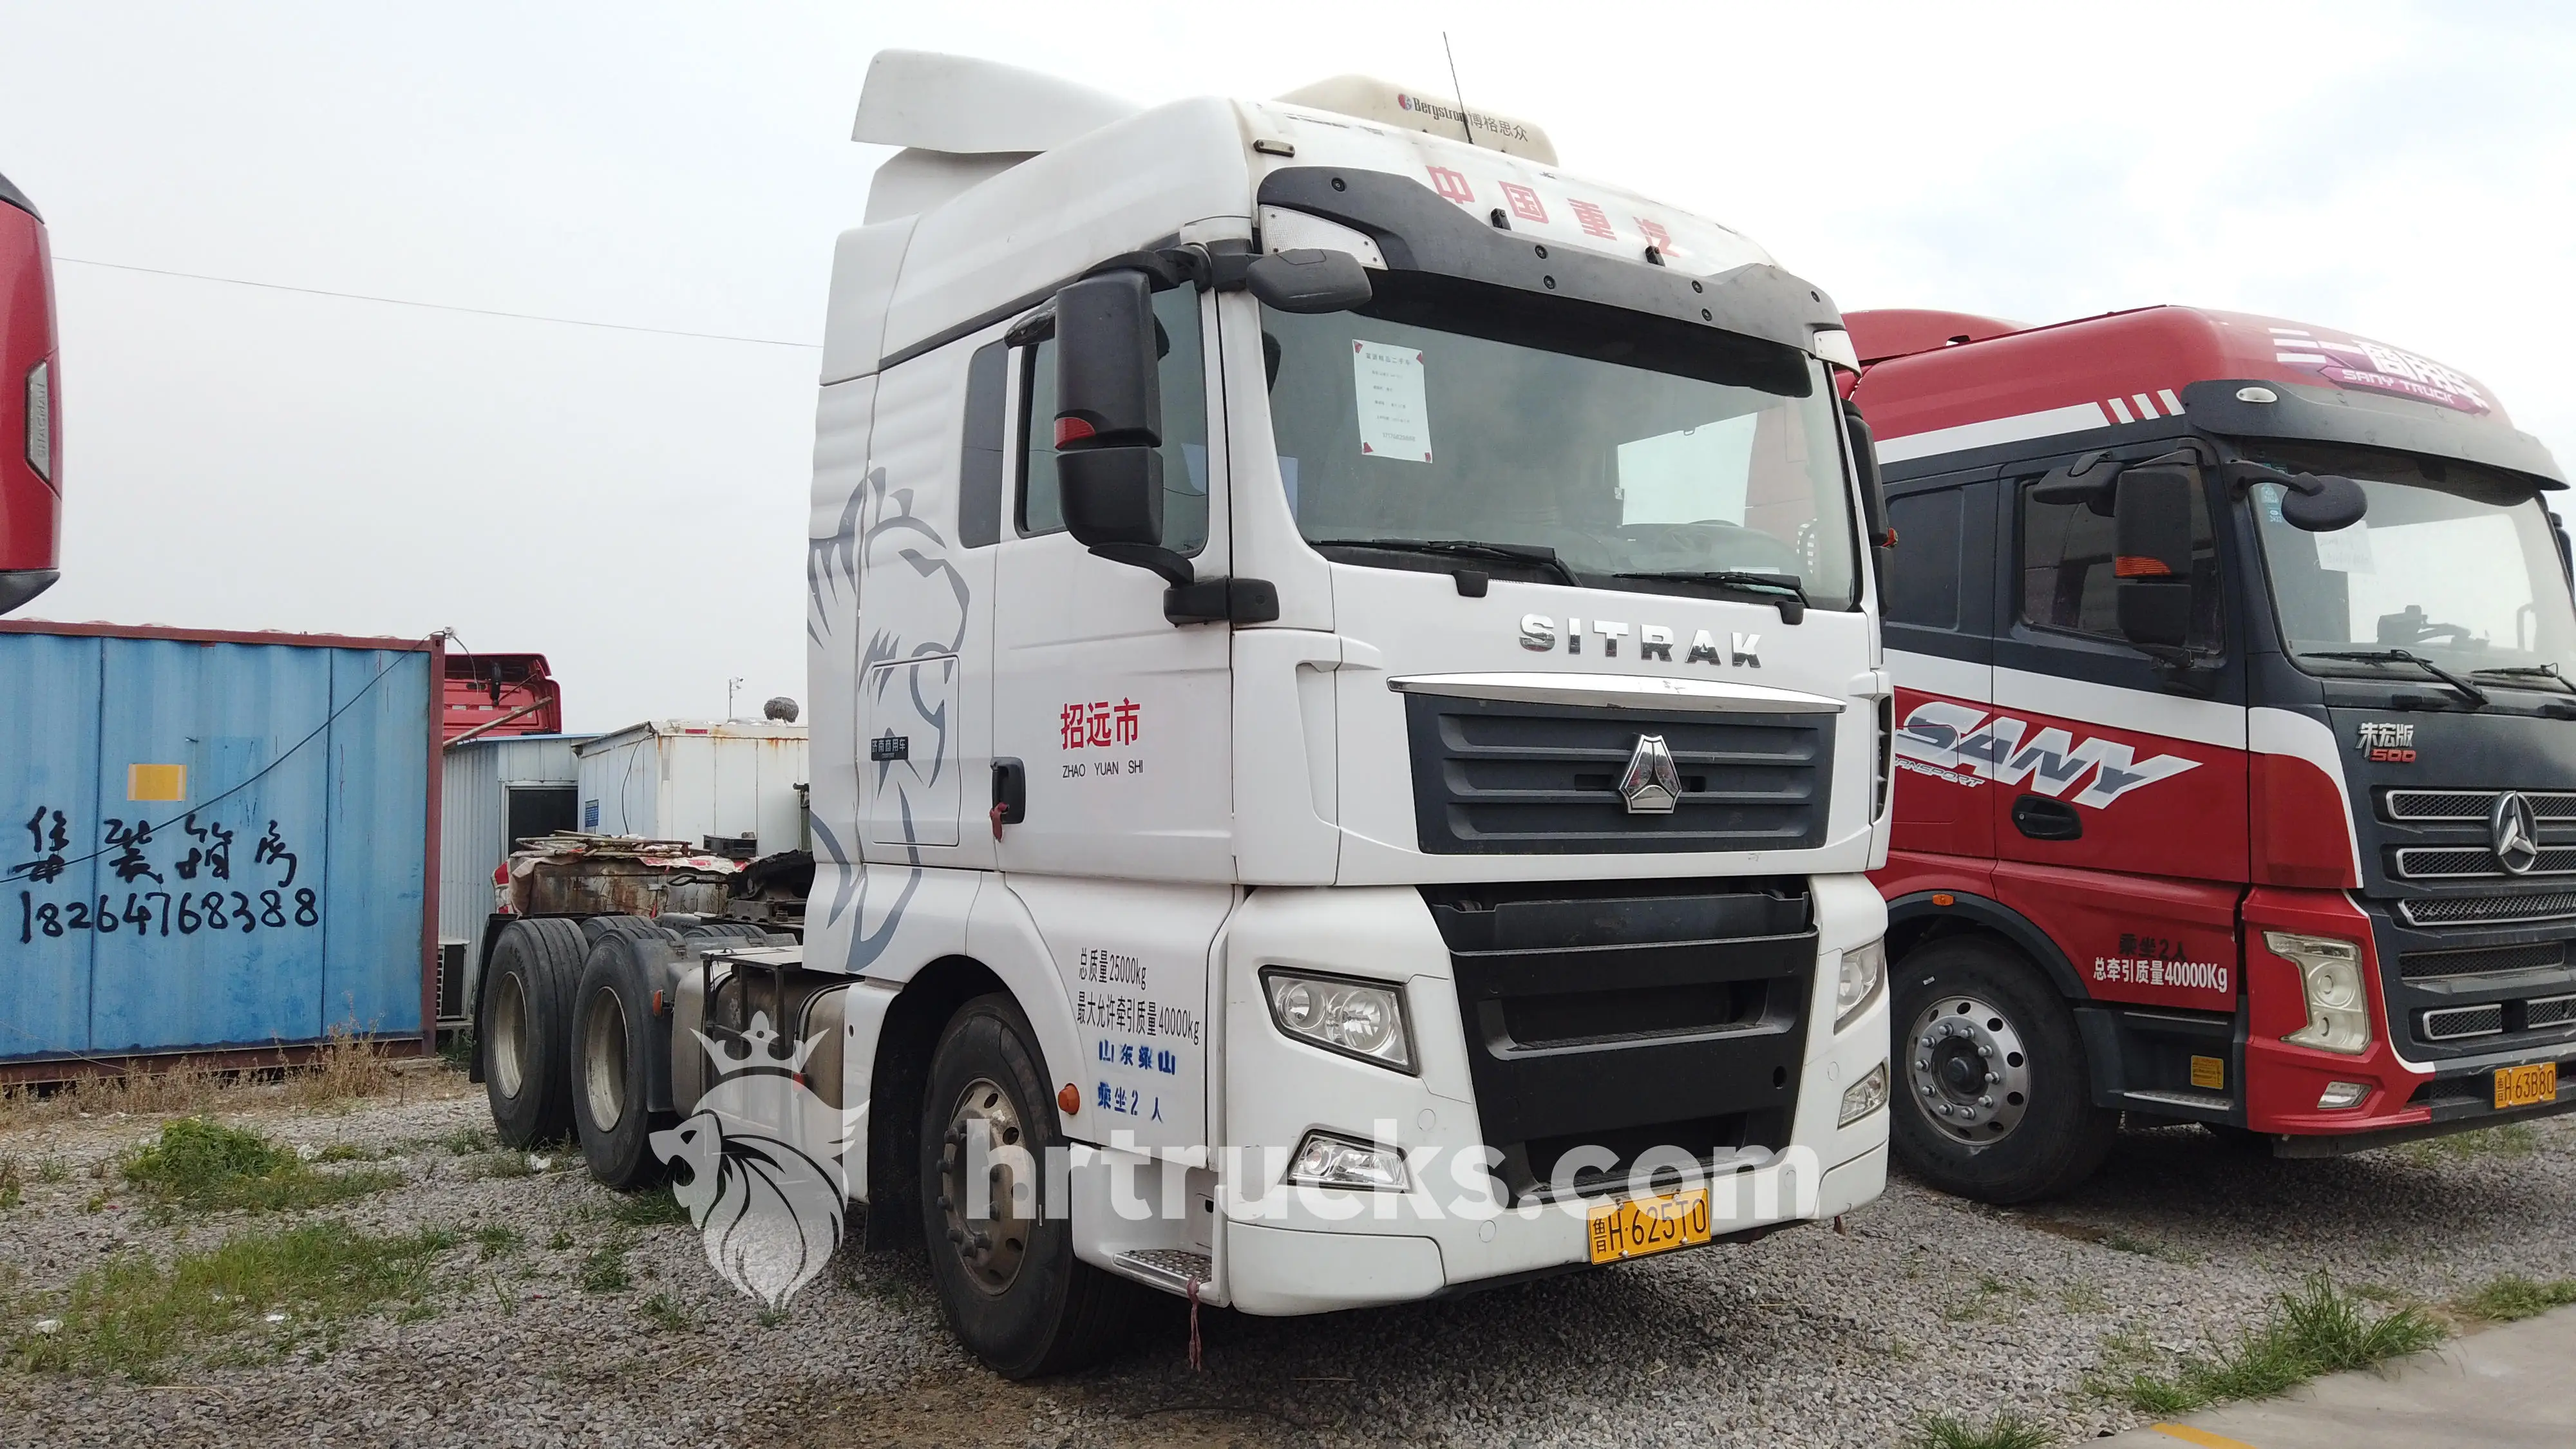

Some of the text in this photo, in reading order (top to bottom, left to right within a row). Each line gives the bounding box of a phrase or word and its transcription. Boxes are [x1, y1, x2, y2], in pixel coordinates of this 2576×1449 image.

[1414, 97, 1528, 142] Bergstrom 博格思众
[1426, 166, 1680, 258] 中国重汽
[2342, 369, 2454, 404] SANY TRUCK
[1519, 613, 1761, 668] SITRAK
[1061, 697, 1141, 750] 招远市
[2355, 722, 2414, 758] 朱宏版
[1063, 759, 1143, 778] ZHAO YUAN SHI
[1895, 701, 2204, 810] SANY
[1895, 756, 1985, 787] ANSPORT
[2370, 748, 2417, 763] 500
[20, 887, 318, 944] 18264768388
[2093, 957, 2228, 993] 总牵引质量40000Kg
[1099, 1039, 1175, 1075] 山东梁山
